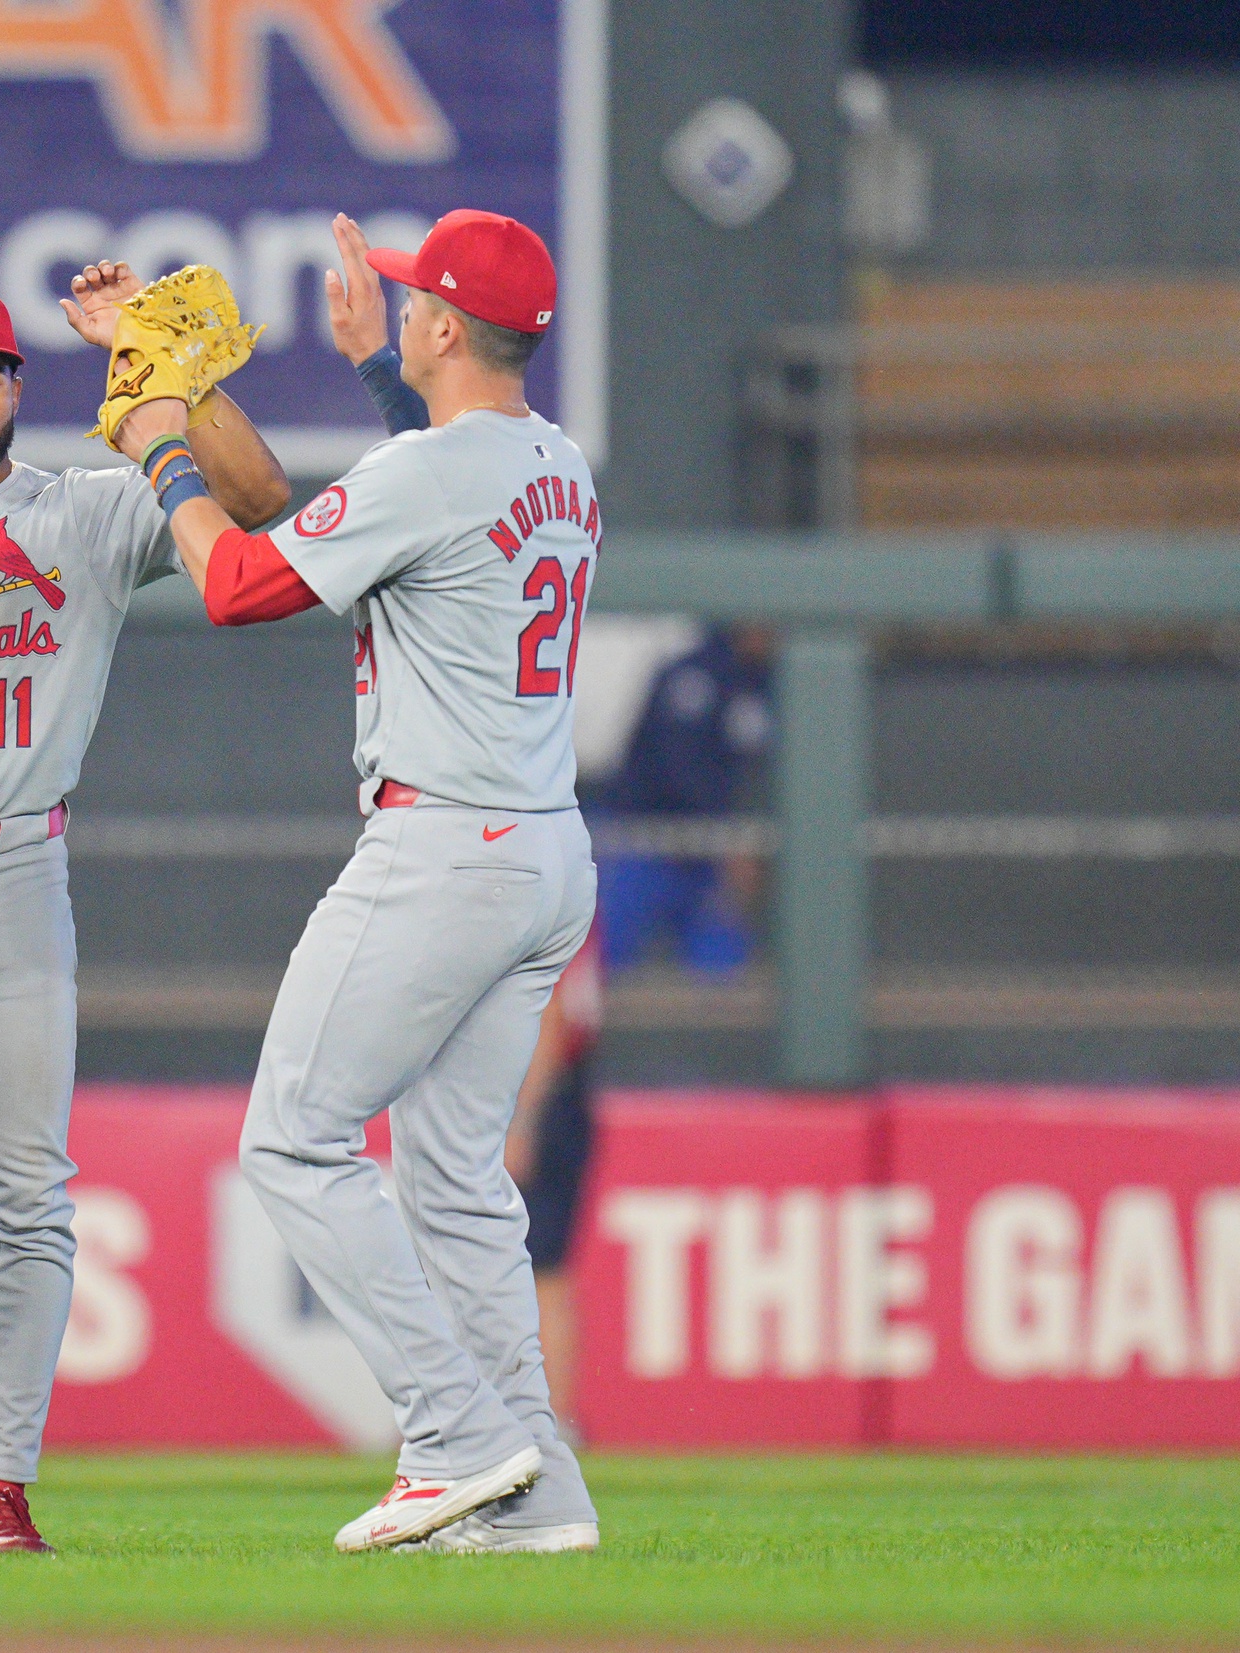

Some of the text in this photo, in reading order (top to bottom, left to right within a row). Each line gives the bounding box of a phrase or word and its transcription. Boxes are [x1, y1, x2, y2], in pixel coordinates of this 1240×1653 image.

[486, 474, 604, 565] NOOTBAA
[515, 555, 591, 699] 21
[603, 1185, 936, 1379] THE
